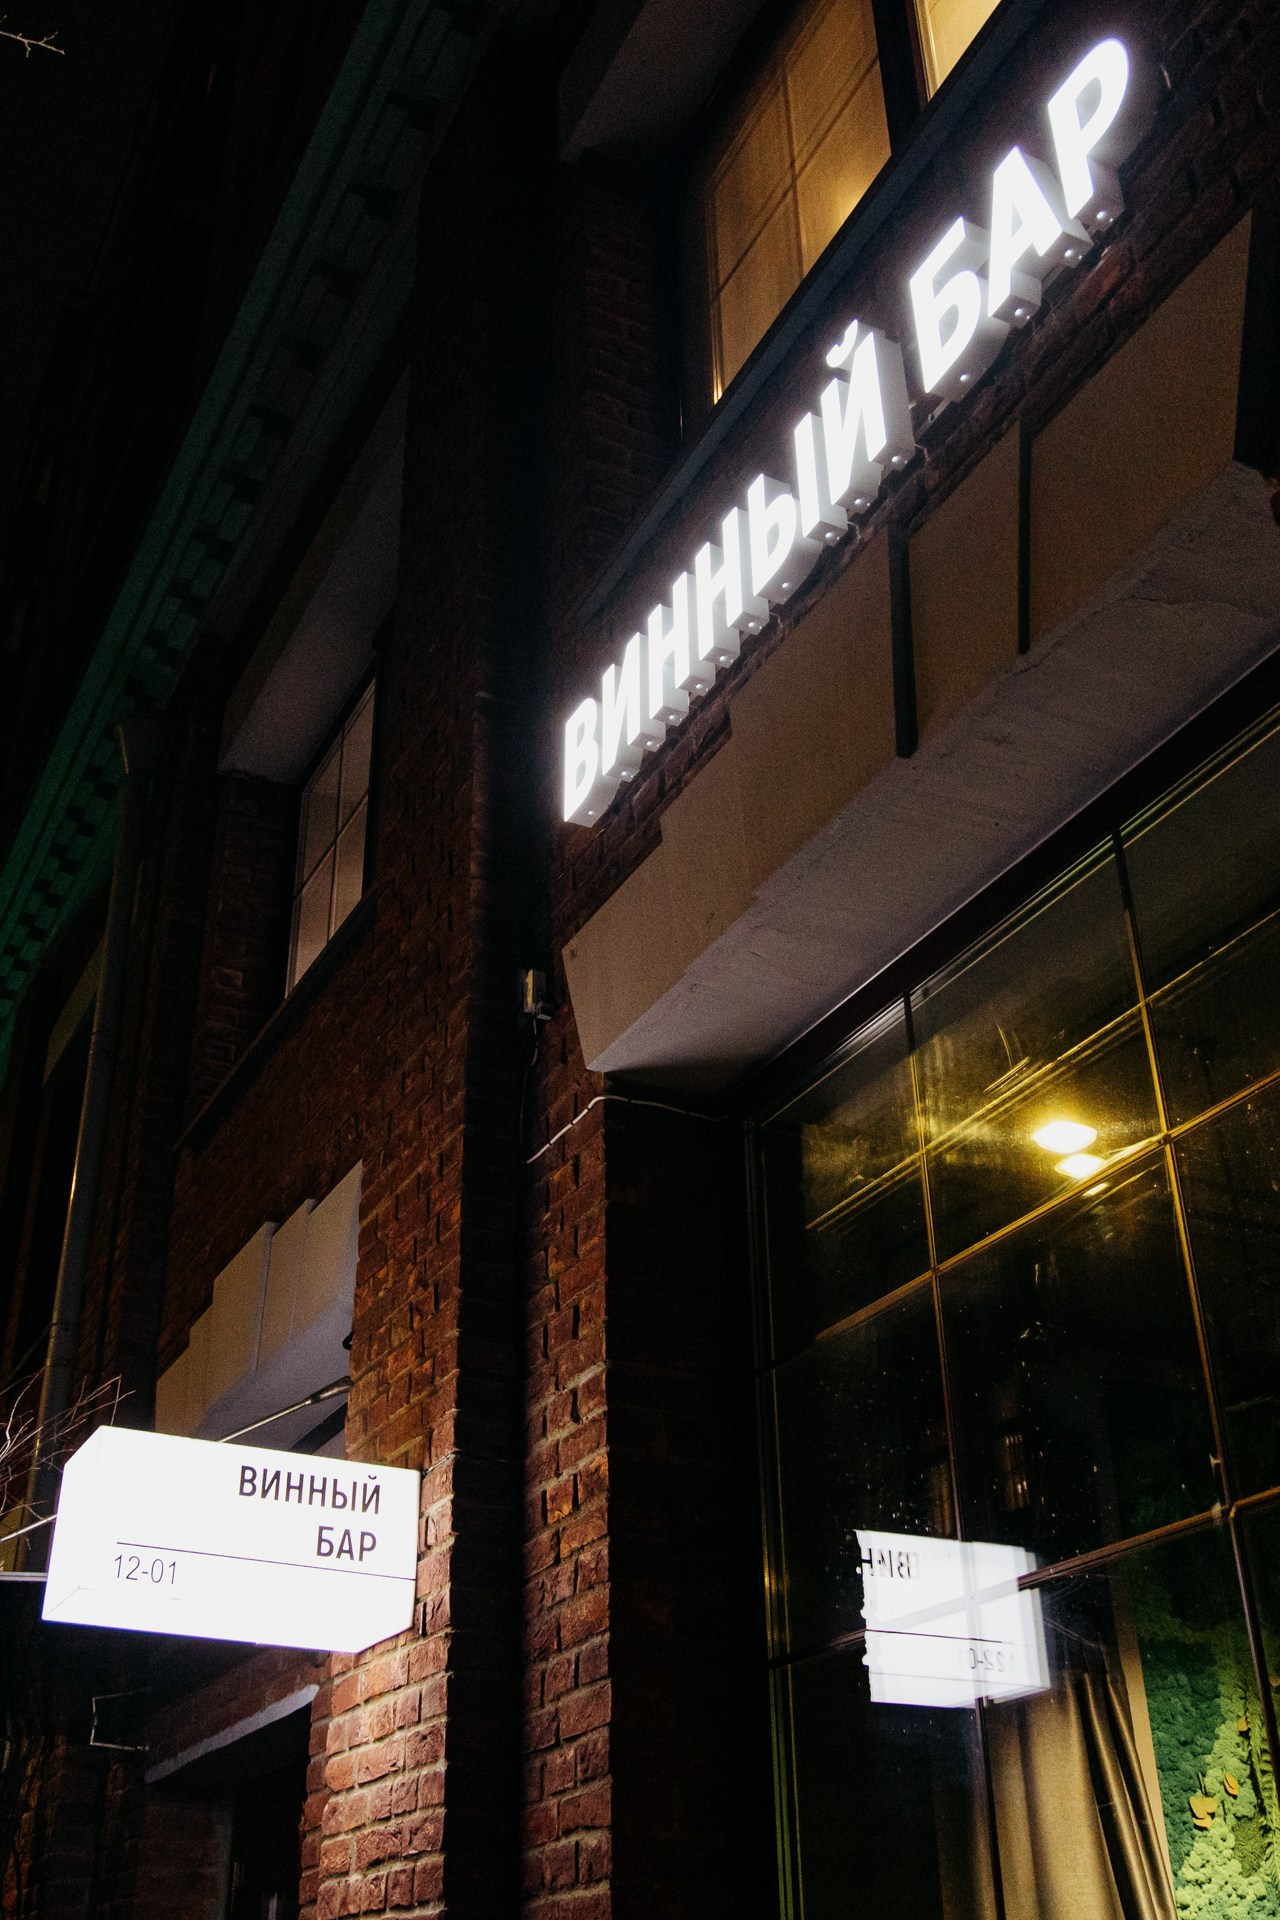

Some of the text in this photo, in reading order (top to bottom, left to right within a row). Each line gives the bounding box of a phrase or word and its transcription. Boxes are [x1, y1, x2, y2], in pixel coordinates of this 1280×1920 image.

[563, 37, 1130, 823] ВИННЫЙ БАР
[238, 1465, 382, 1515] ВИННЫЙ
[315, 1525, 378, 1562] БАР
[113, 1554, 178, 1585] 12-01
